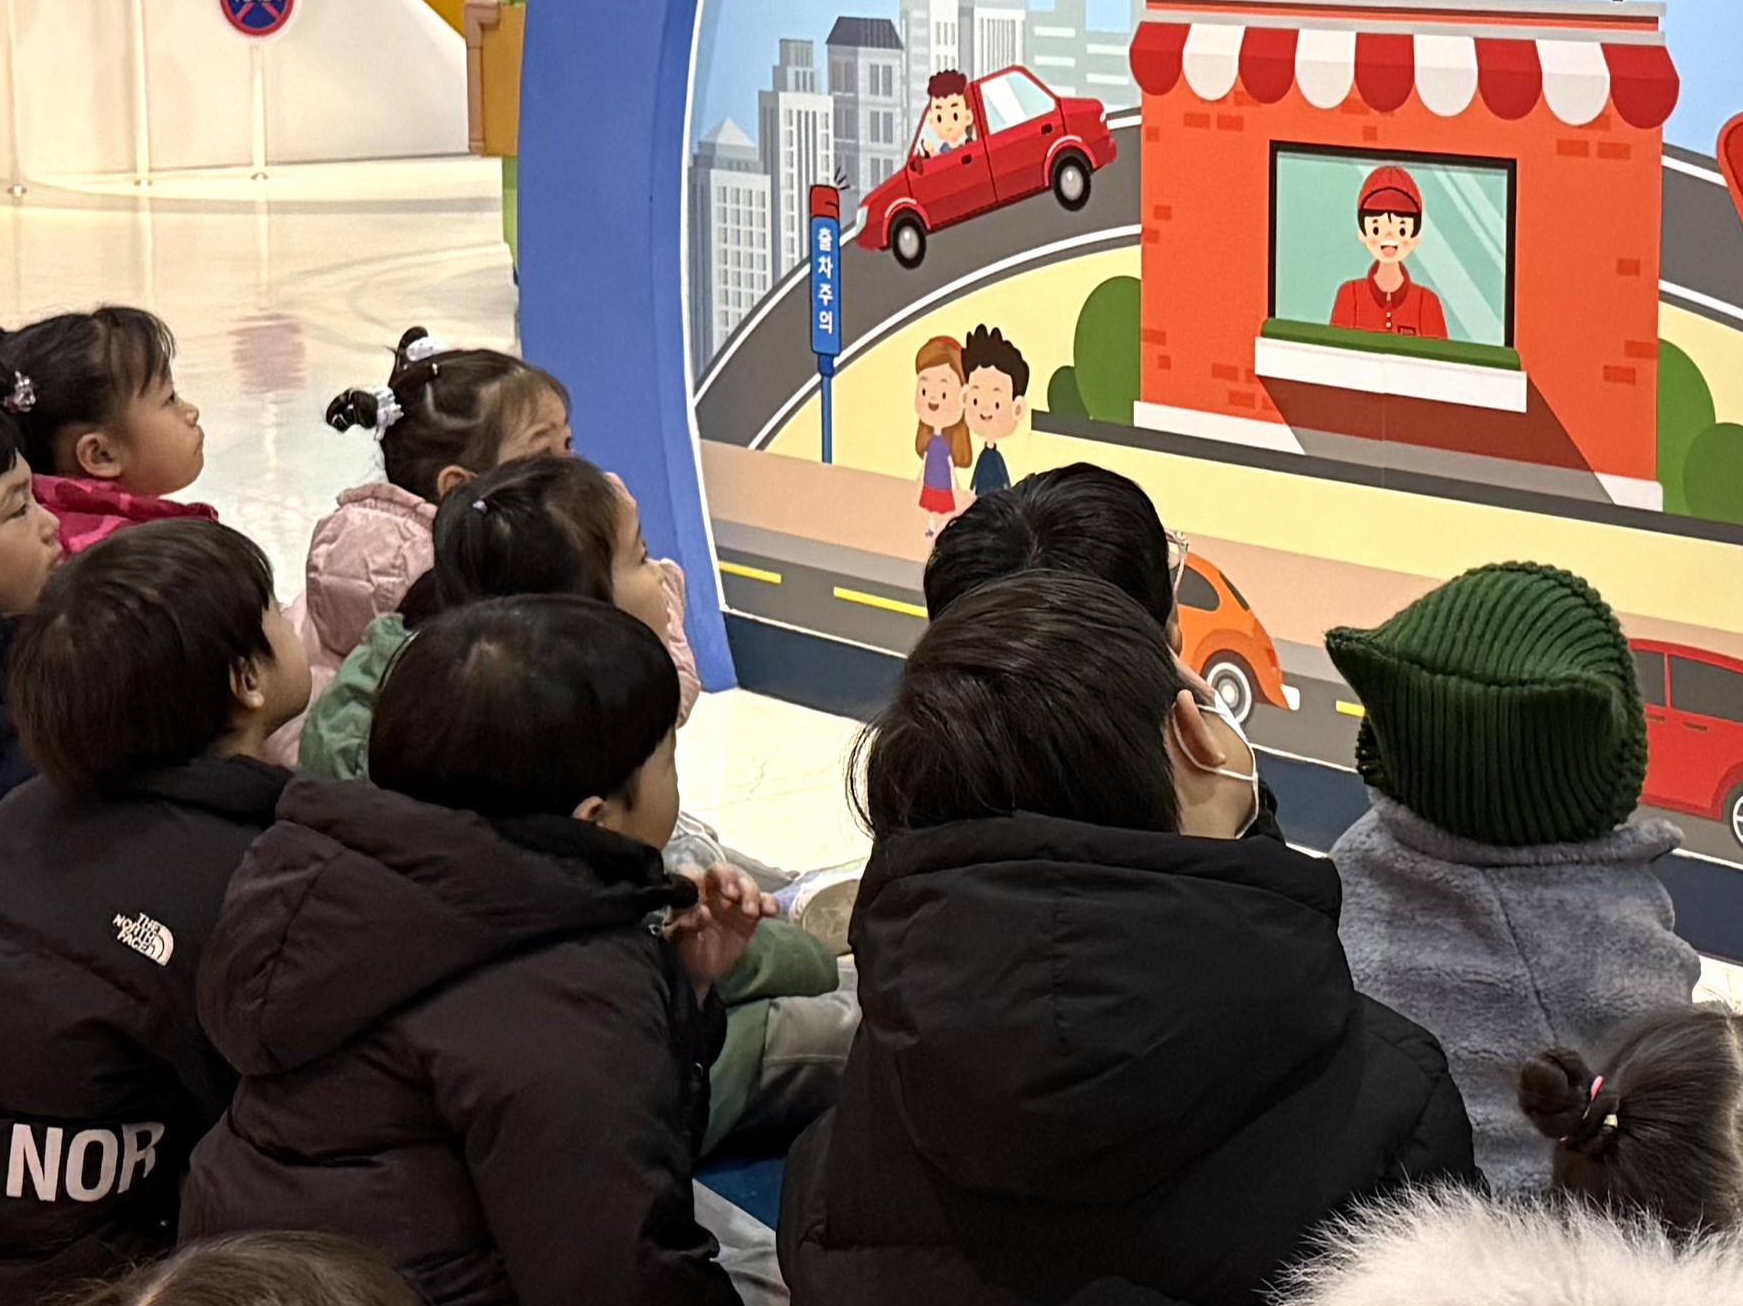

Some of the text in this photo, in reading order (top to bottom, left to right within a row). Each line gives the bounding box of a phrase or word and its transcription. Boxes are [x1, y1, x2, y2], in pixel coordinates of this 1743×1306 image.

[818, 227, 833, 335] 출차주의
[138, 913, 160, 933] THE
[117, 930, 150, 952] FACE
